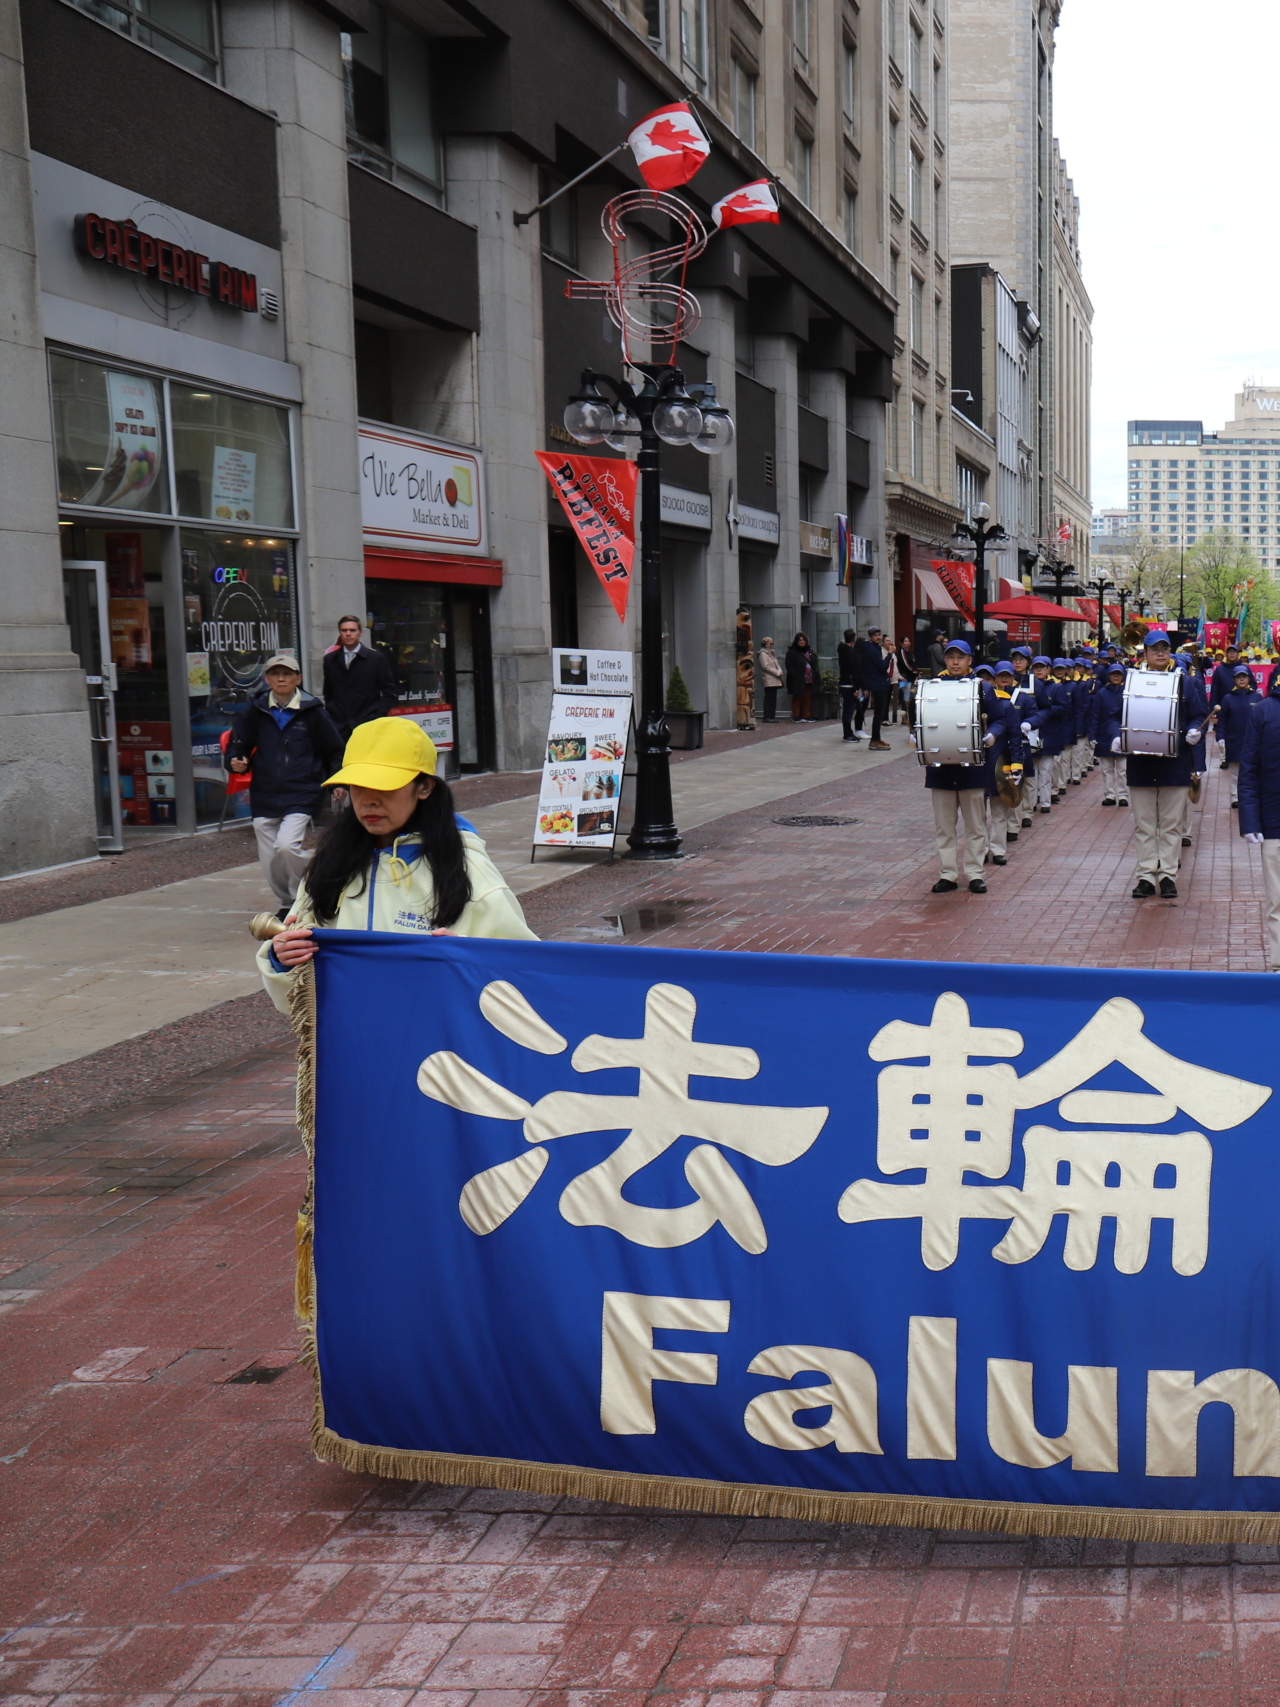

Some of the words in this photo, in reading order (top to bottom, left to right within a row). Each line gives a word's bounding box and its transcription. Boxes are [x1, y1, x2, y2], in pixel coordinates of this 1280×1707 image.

[217, 261, 258, 313] RIM
[362, 452, 398, 498] Vie
[398, 462, 444, 504] Bella
[581, 472, 626, 541] OTTAWA
[412, 508, 442, 526] Market
[442, 513, 450, 527] &
[452, 514, 470, 530] Deli
[551, 461, 629, 583] RIBFEST
[214, 567, 248, 583] OPEN
[937, 564, 971, 614] RIBFEST
[260, 622, 280, 651] RIM
[597, 660, 616, 669] Coffee
[590, 672, 599, 681] Hot
[600, 673, 628, 682] Chocolate
[398, 691, 407, 700] and
[408, 690, 422, 700] Lunch
[602, 708, 615, 718] RIM
[437, 717, 450, 725] COFFEE
[552, 732, 582, 740] SAVOURY
[594, 733, 616, 742] SWEET
[550, 768, 575, 776] GELATO
[394, 919, 416, 928] FALUN
